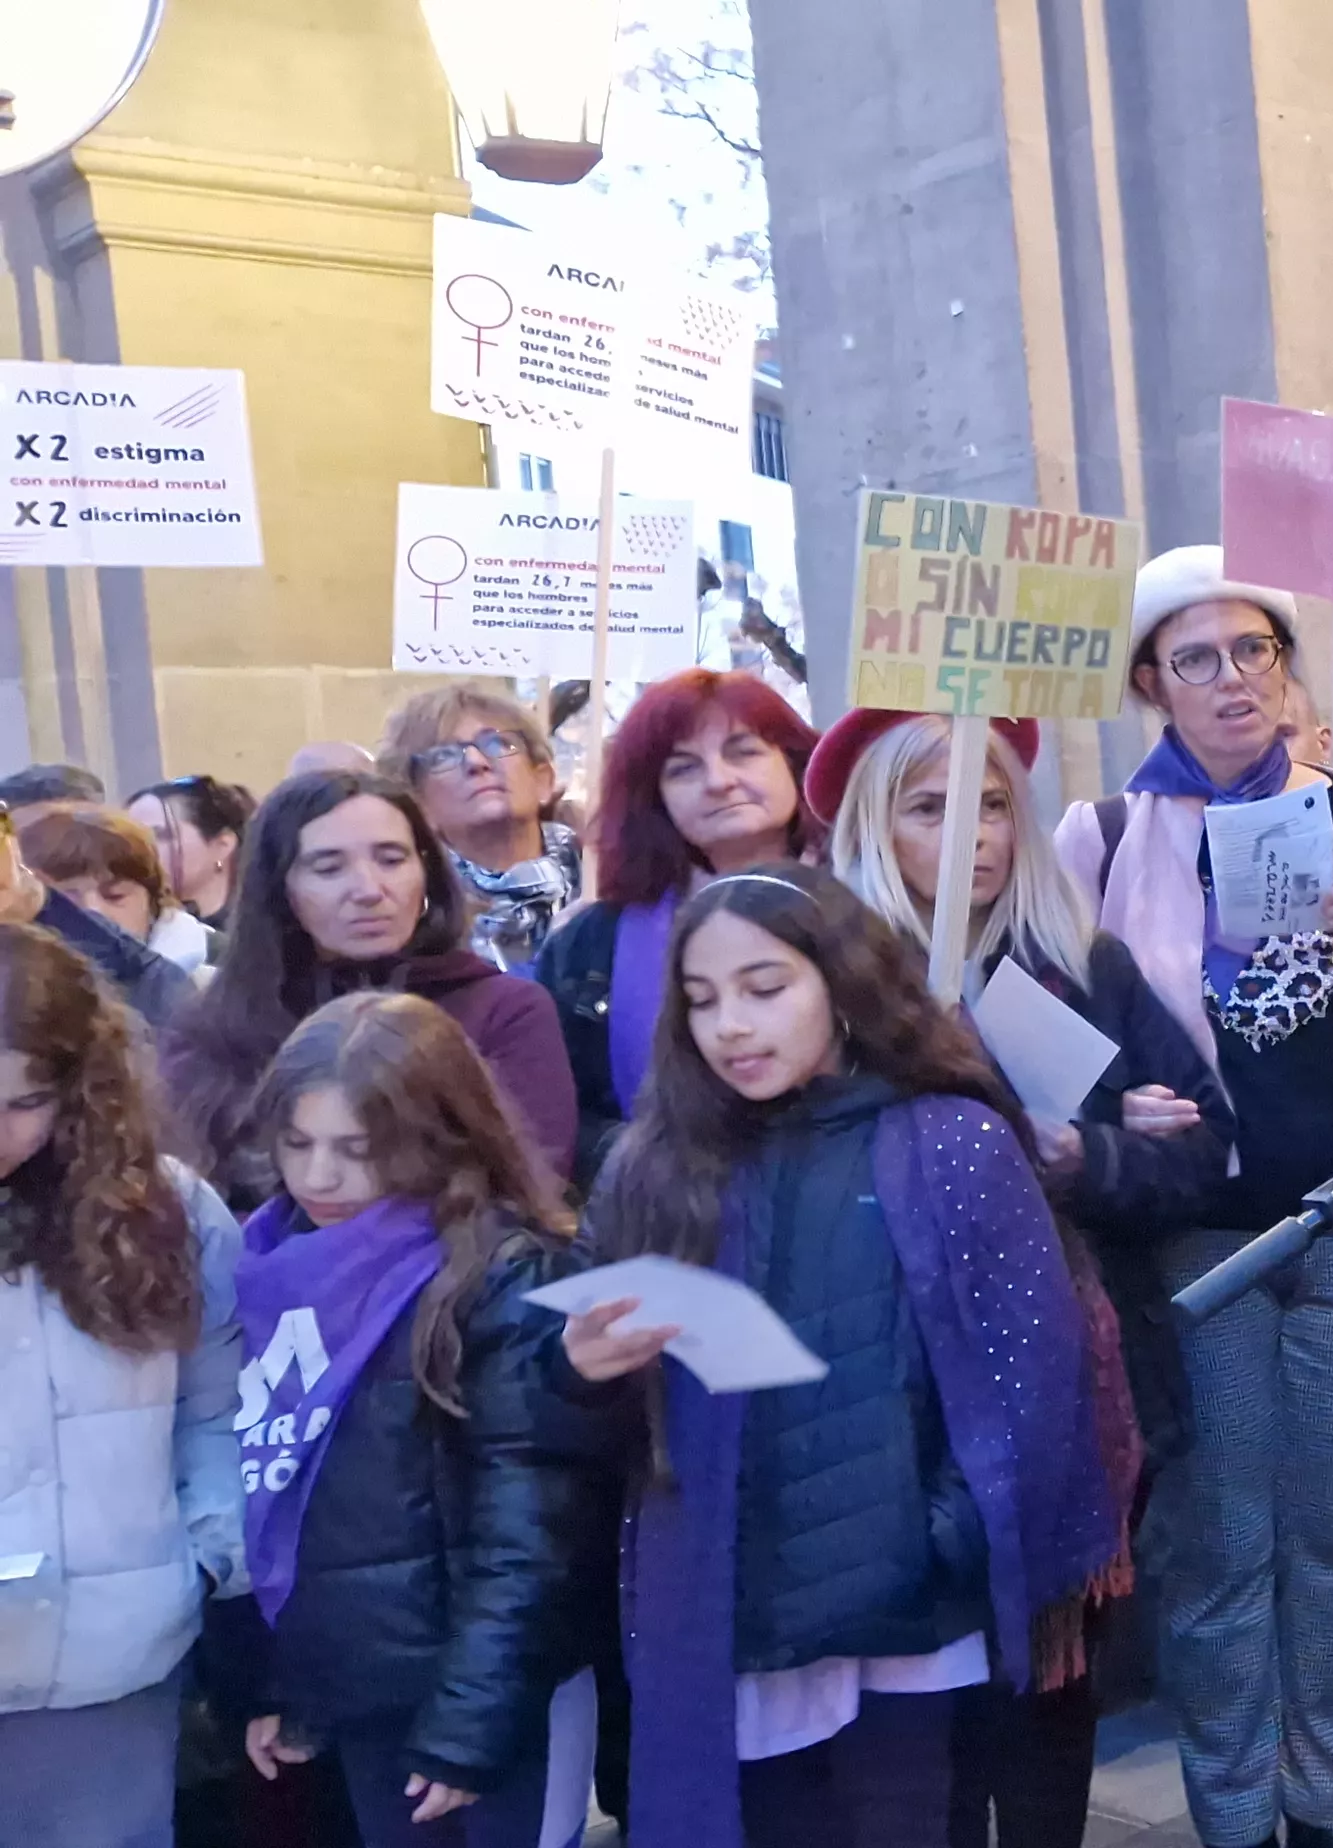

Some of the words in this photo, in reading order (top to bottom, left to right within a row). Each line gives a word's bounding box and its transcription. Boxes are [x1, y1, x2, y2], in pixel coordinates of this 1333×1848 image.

[520, 323, 571, 343] tardan
[584, 334, 612, 355] 26,
[521, 305, 553, 320] con
[668, 343, 721, 366] mental
[520, 339, 548, 354] que
[553, 346, 575, 360] los
[520, 355, 554, 370] para
[559, 364, 611, 383] accede
[634, 398, 651, 409] de
[654, 403, 691, 420] salud
[694, 416, 739, 434] mental
[49, 434, 70, 462] 2
[94, 442, 205, 464] estigma
[10, 476, 42, 487] con
[49, 476, 159, 489] enfermedad
[165, 478, 227, 490] mental
[49, 501, 69, 528] 2
[79, 507, 242, 523] discriminación
[864, 492, 987, 555] CON
[1005, 507, 1116, 569] ROPA
[474, 556, 504, 566] con
[509, 558, 600, 572] enfermeda
[612, 563, 666, 574] mental
[473, 574, 520, 585] tardan
[580, 580, 623, 590] mees
[627, 582, 653, 591] más
[473, 589, 500, 599] que
[503, 589, 523, 600] los
[528, 591, 588, 603] hombres
[472, 604, 504, 614] para
[508, 605, 563, 616] acceder
[472, 618, 574, 631] especializados
[606, 624, 636, 634] alud
[640, 624, 684, 634] mental
[942, 616, 1111, 668] CUERPO
[857, 660, 925, 707] NO
[937, 665, 991, 716] SE
[1003, 669, 1104, 718] TOCA
